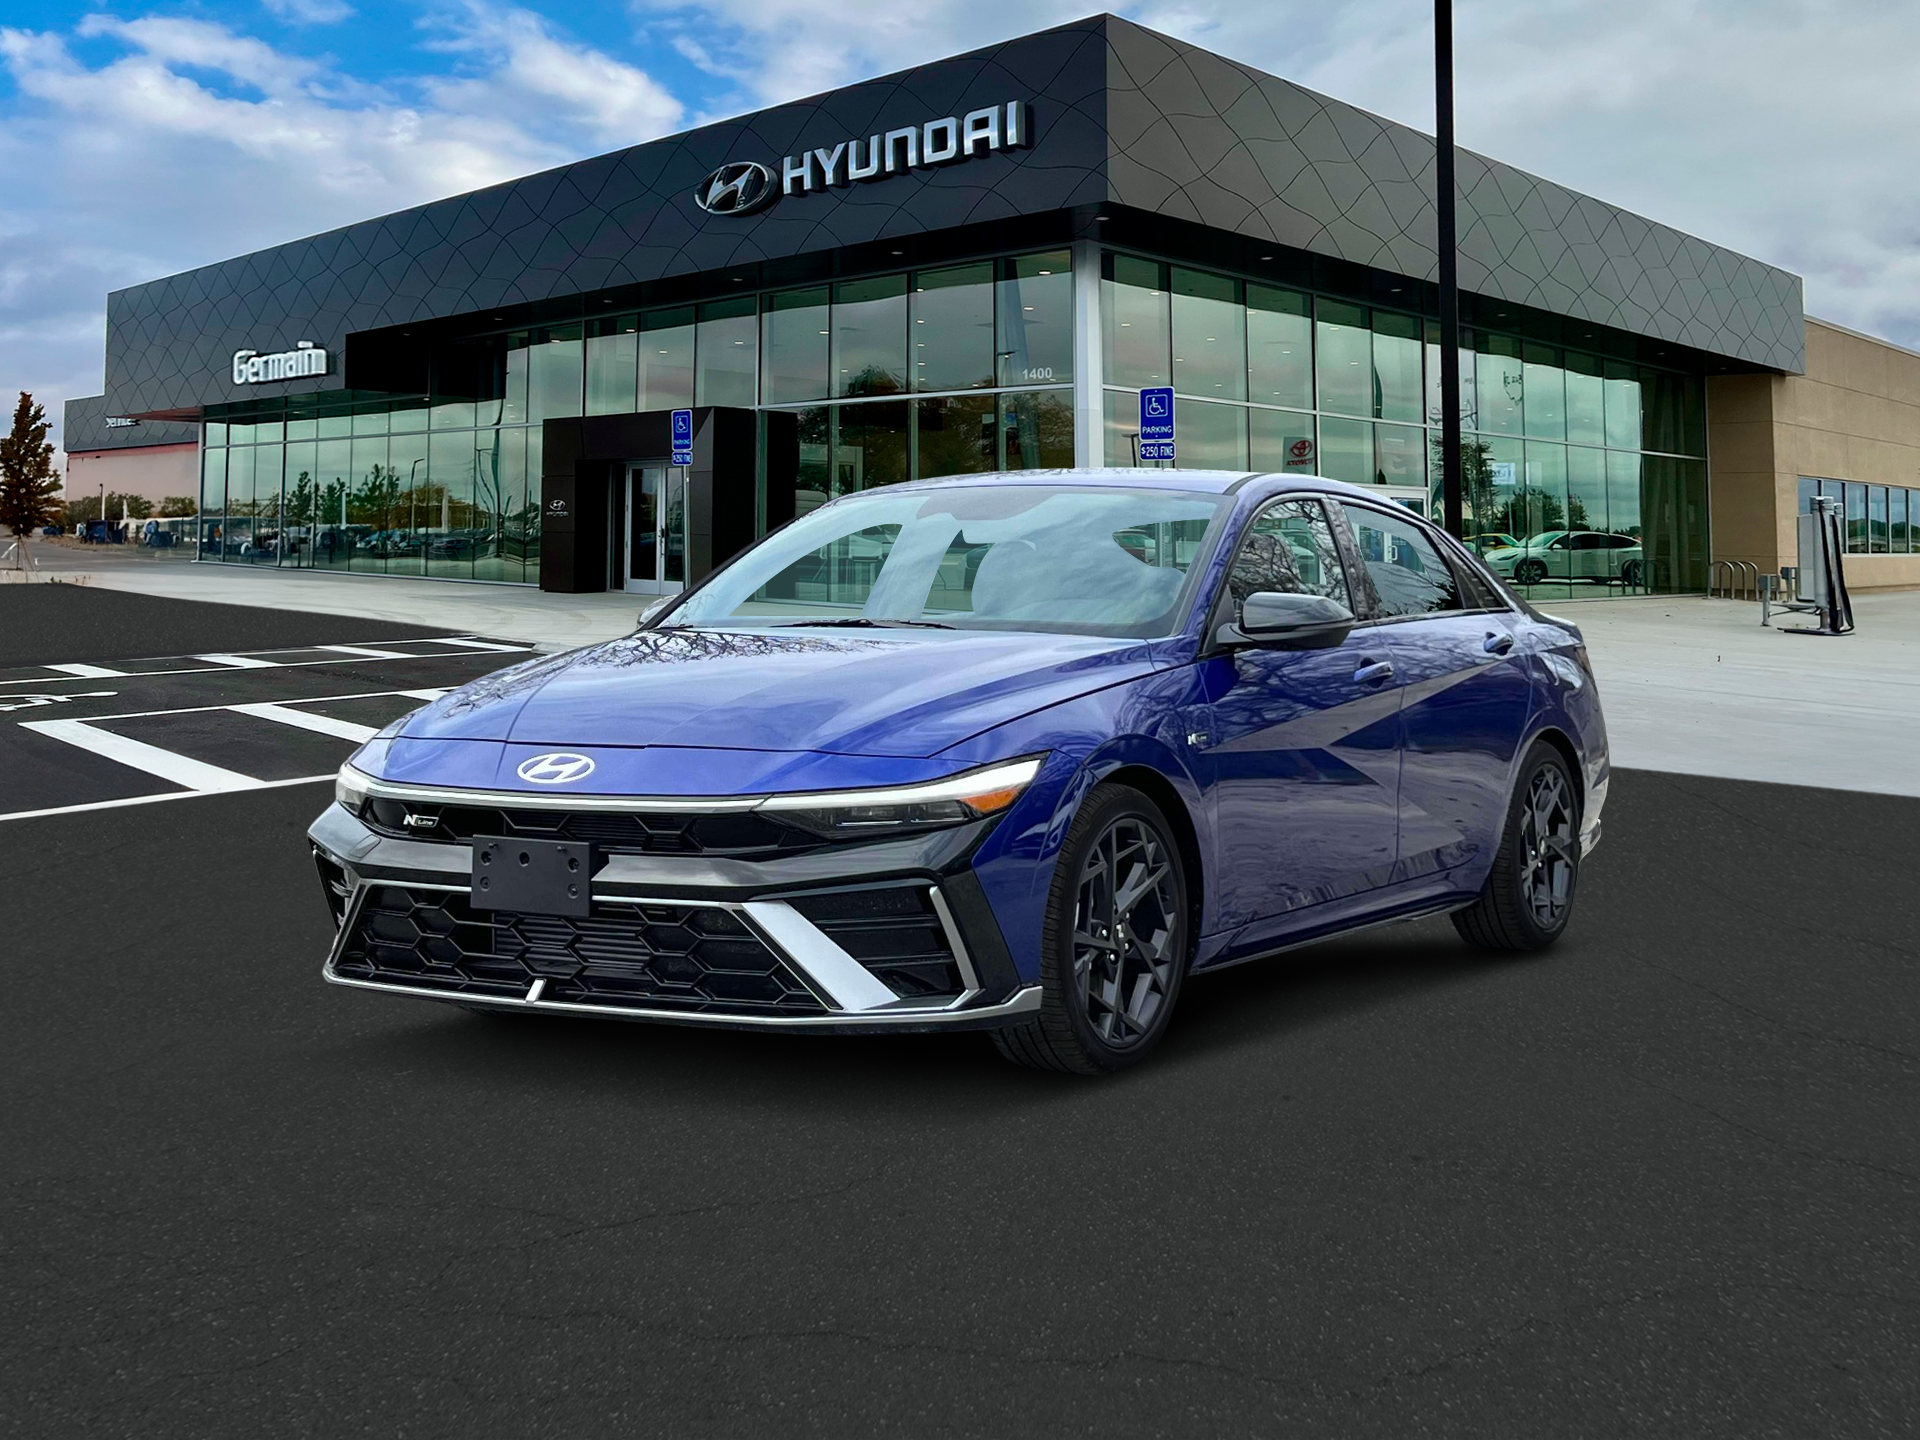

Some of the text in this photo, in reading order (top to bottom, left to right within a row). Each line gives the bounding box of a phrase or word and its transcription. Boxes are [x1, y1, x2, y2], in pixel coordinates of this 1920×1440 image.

[782, 101, 1024, 195] HYUNDAI
[233, 341, 327, 384] Germain
[1022, 367, 1052, 380] 1400
[1142, 425, 1172, 434] PARKING
[1141, 446, 1174, 458] $250 FINE
